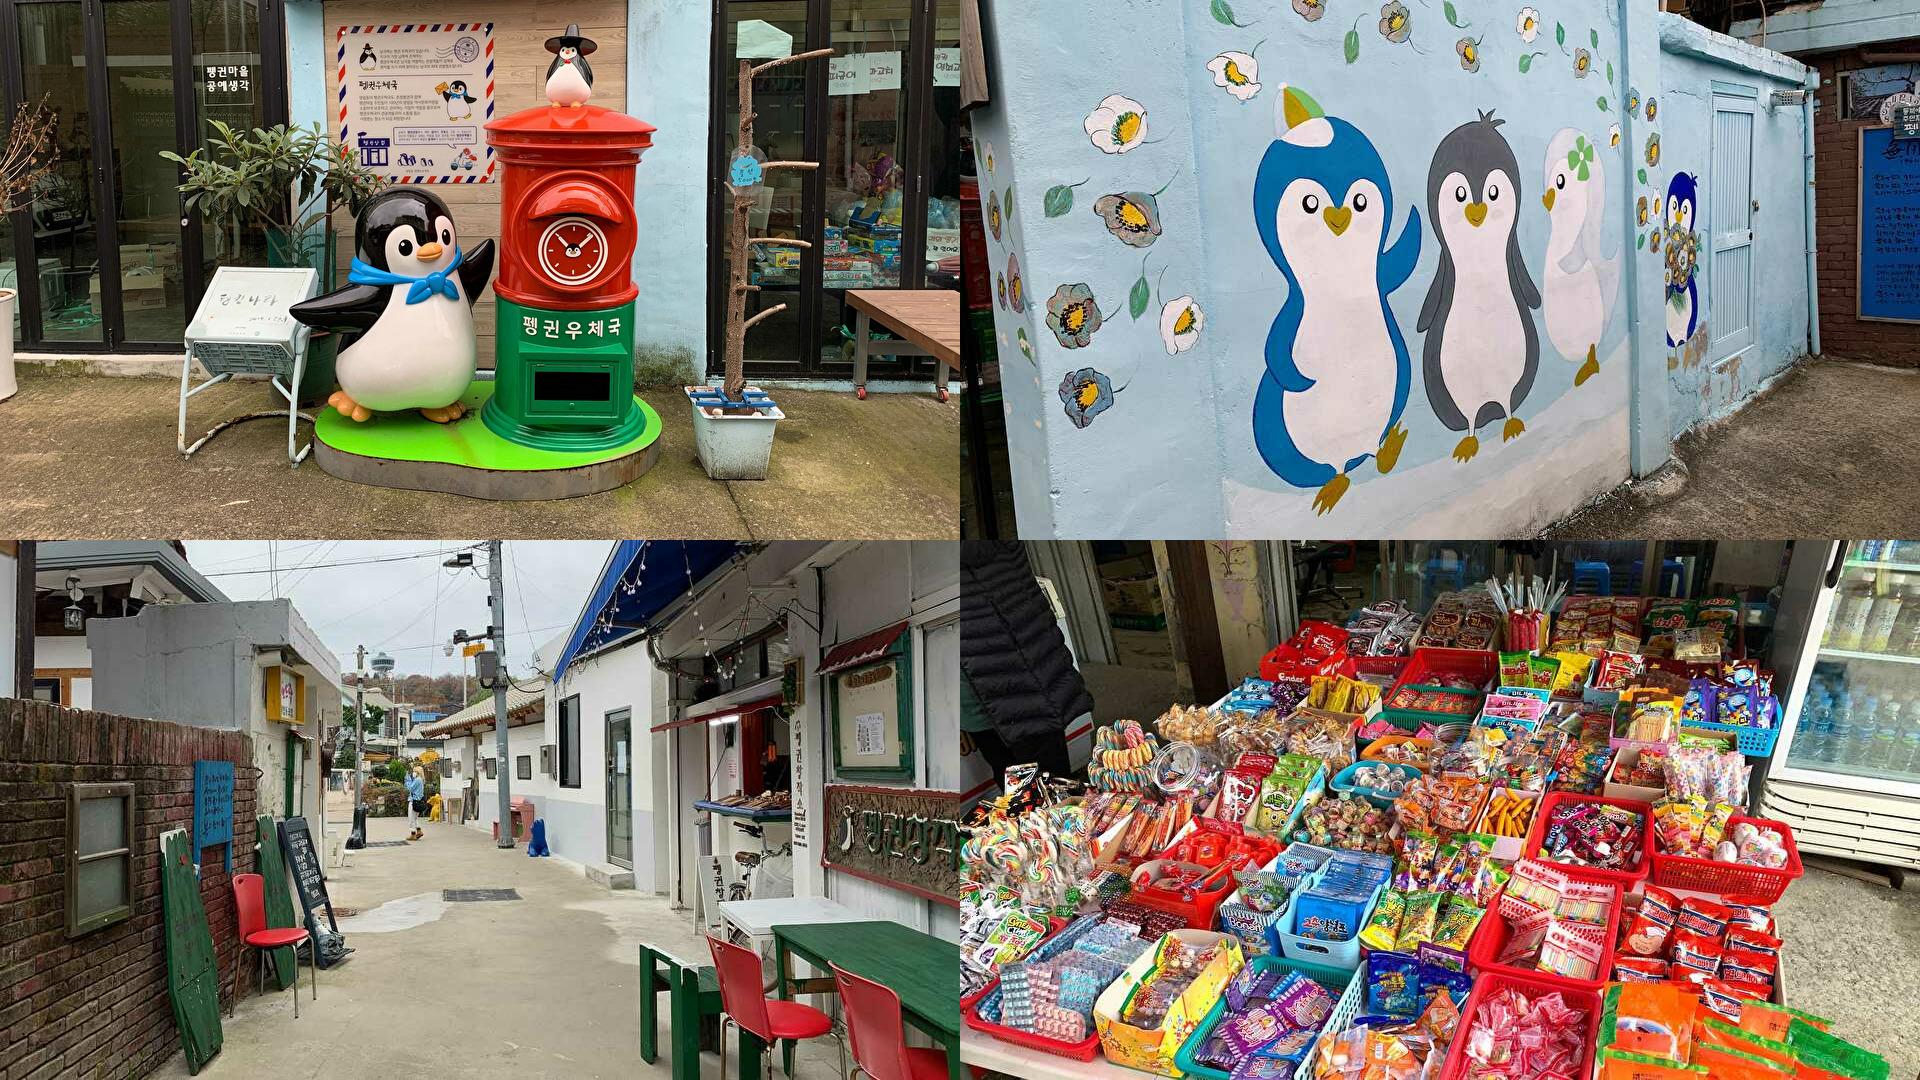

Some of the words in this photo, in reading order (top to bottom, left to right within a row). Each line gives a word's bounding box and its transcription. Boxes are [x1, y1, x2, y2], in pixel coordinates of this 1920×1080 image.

[206, 65, 249, 78] 펭귄마을
[206, 80, 250, 92] 공예생각
[523, 316, 621, 340] 펭귄우체국
[712, 864, 725, 905] 펭귄창
